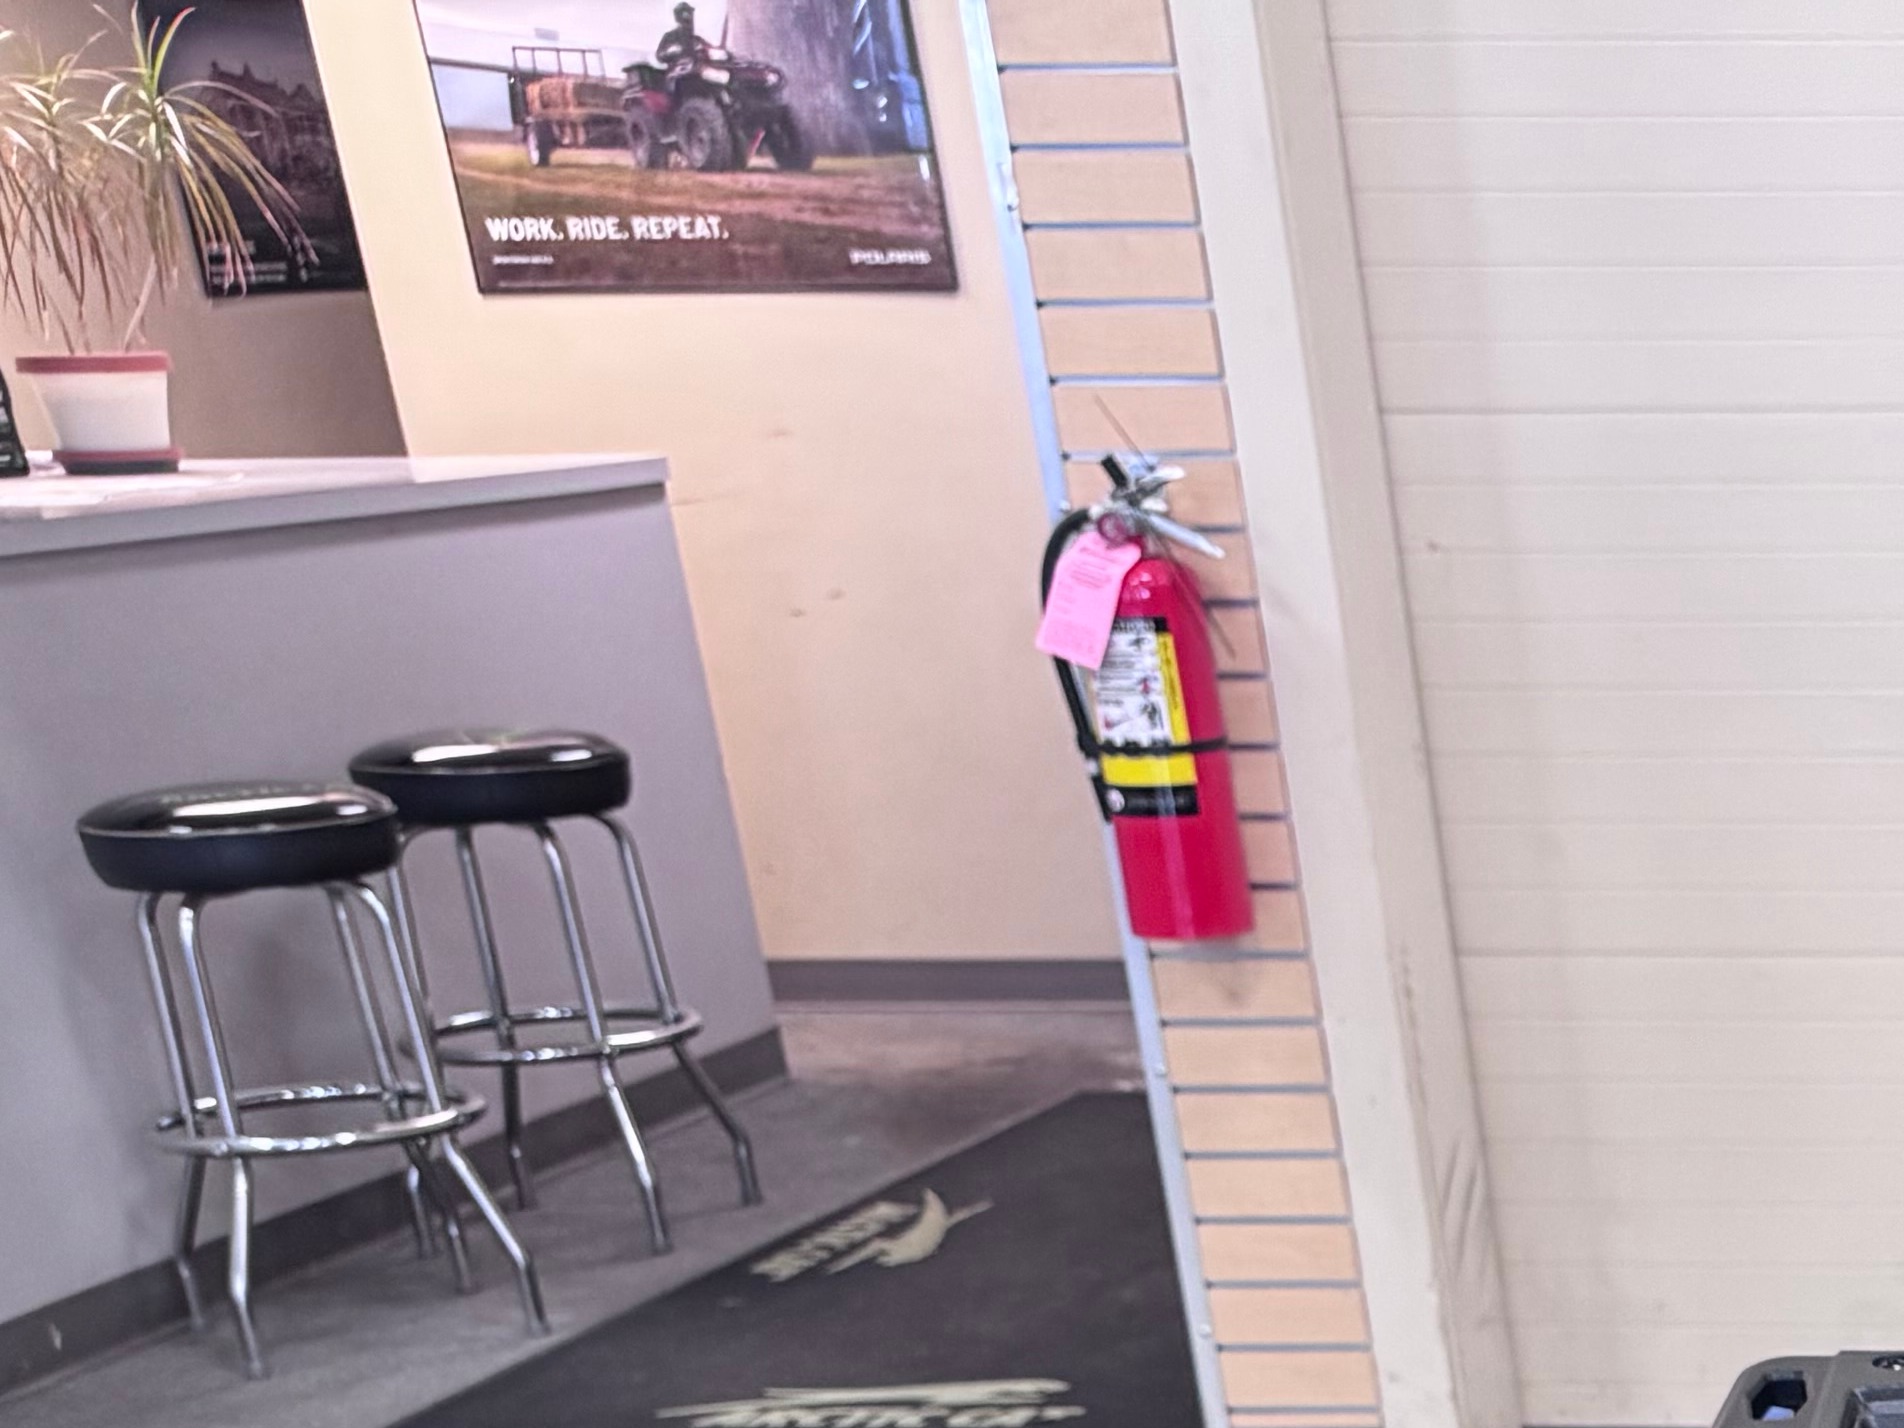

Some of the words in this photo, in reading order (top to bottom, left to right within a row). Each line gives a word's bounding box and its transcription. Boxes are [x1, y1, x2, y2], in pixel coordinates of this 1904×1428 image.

[484, 216, 564, 242] WORK.
[565, 216, 629, 242] RIDE.
[630, 215, 730, 242] REPEAT.
